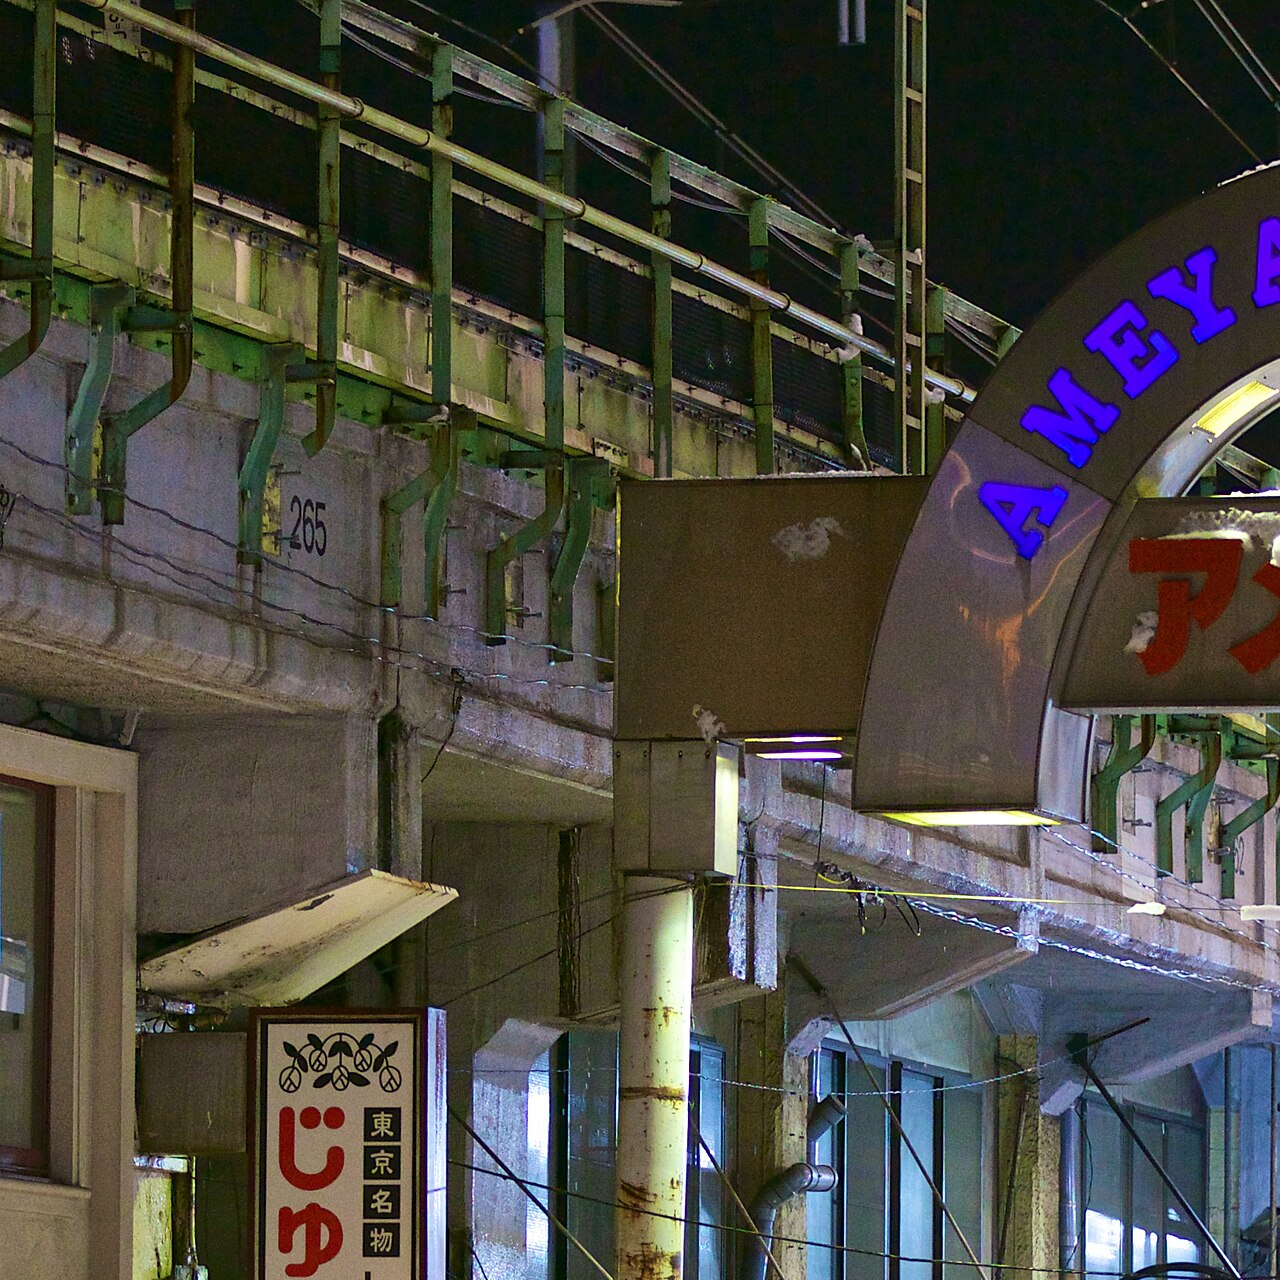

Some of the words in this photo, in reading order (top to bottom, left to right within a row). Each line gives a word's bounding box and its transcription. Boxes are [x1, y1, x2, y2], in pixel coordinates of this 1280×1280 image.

[289, 495, 327, 557] 265
[365, 1109, 399, 1256] 東京名物
